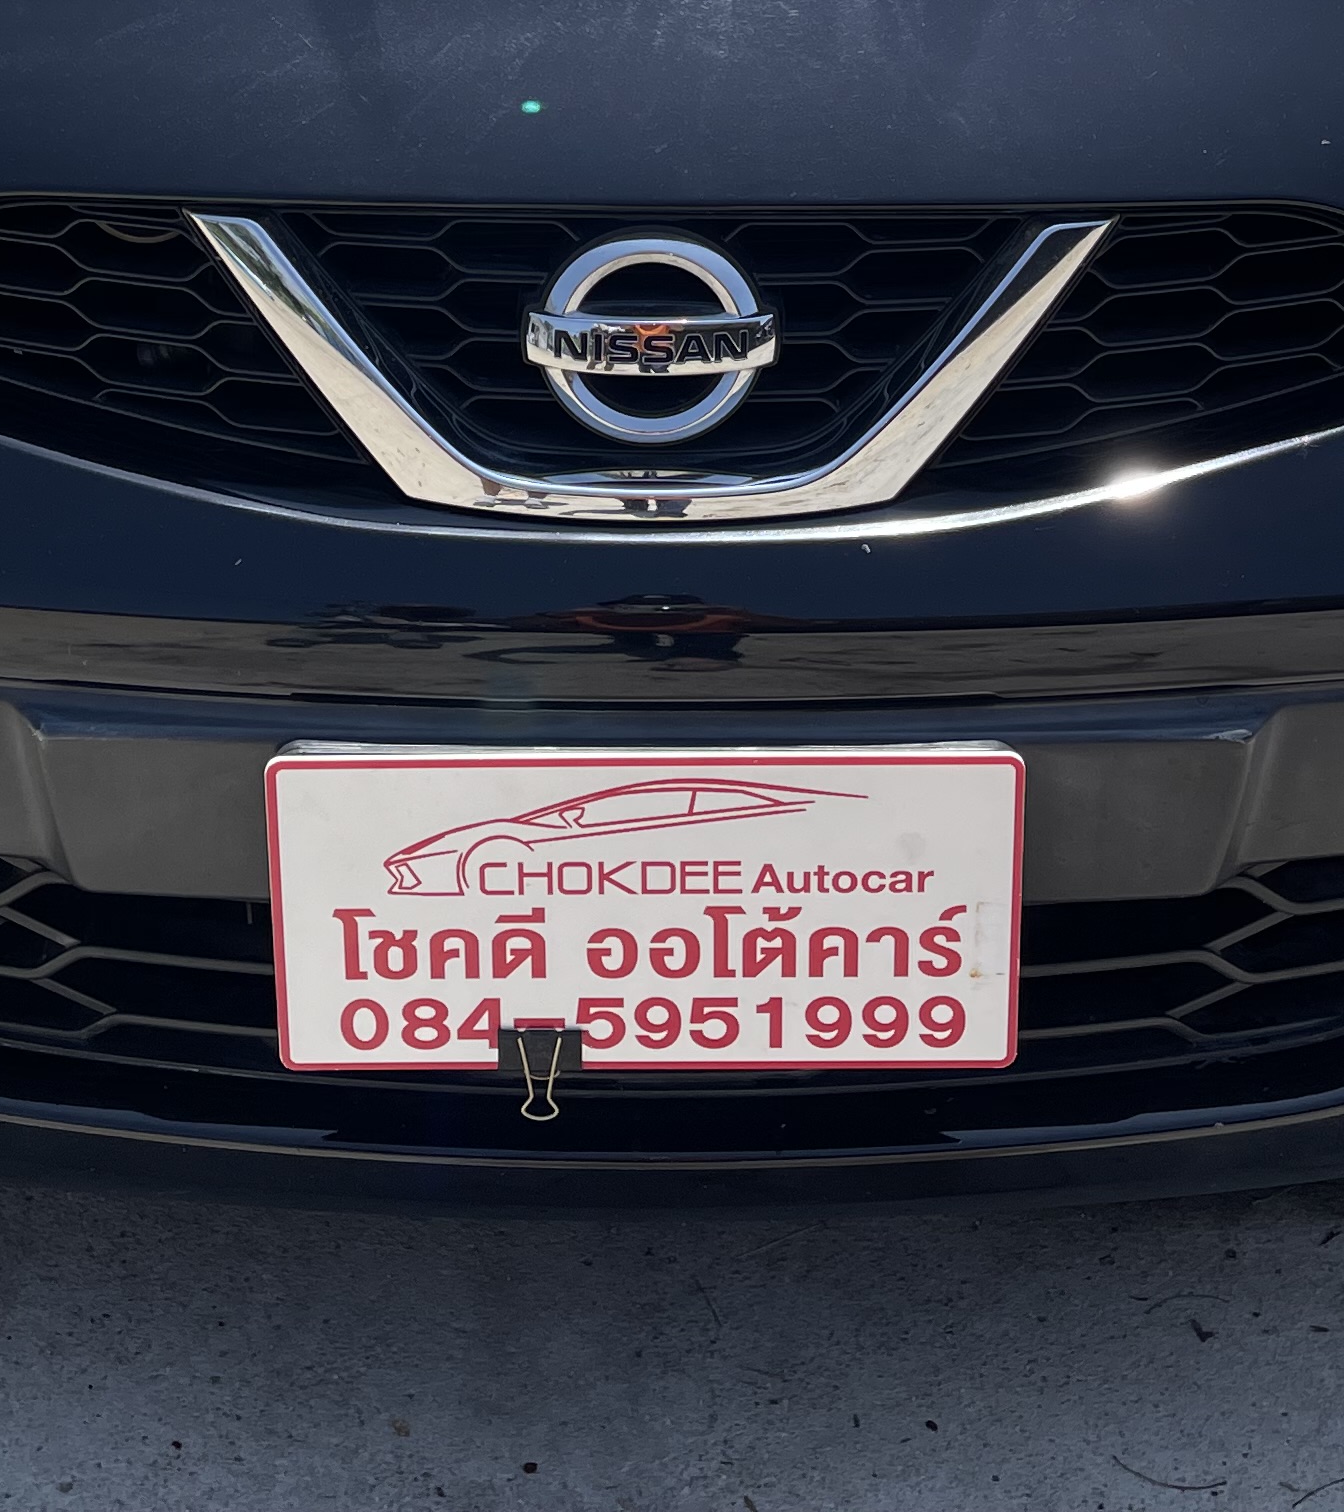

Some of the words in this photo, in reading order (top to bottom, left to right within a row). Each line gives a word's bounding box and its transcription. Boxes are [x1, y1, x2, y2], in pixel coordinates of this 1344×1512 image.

[553, 328, 749, 366] NISSAN
[478, 859, 743, 897] CHOKDEE
[751, 862, 935, 895] Autocar
[332, 905, 548, 982] โชคดี
[585, 903, 968, 980] ออโต้คาร์
[339, 994, 967, 1052] 084-5951999
